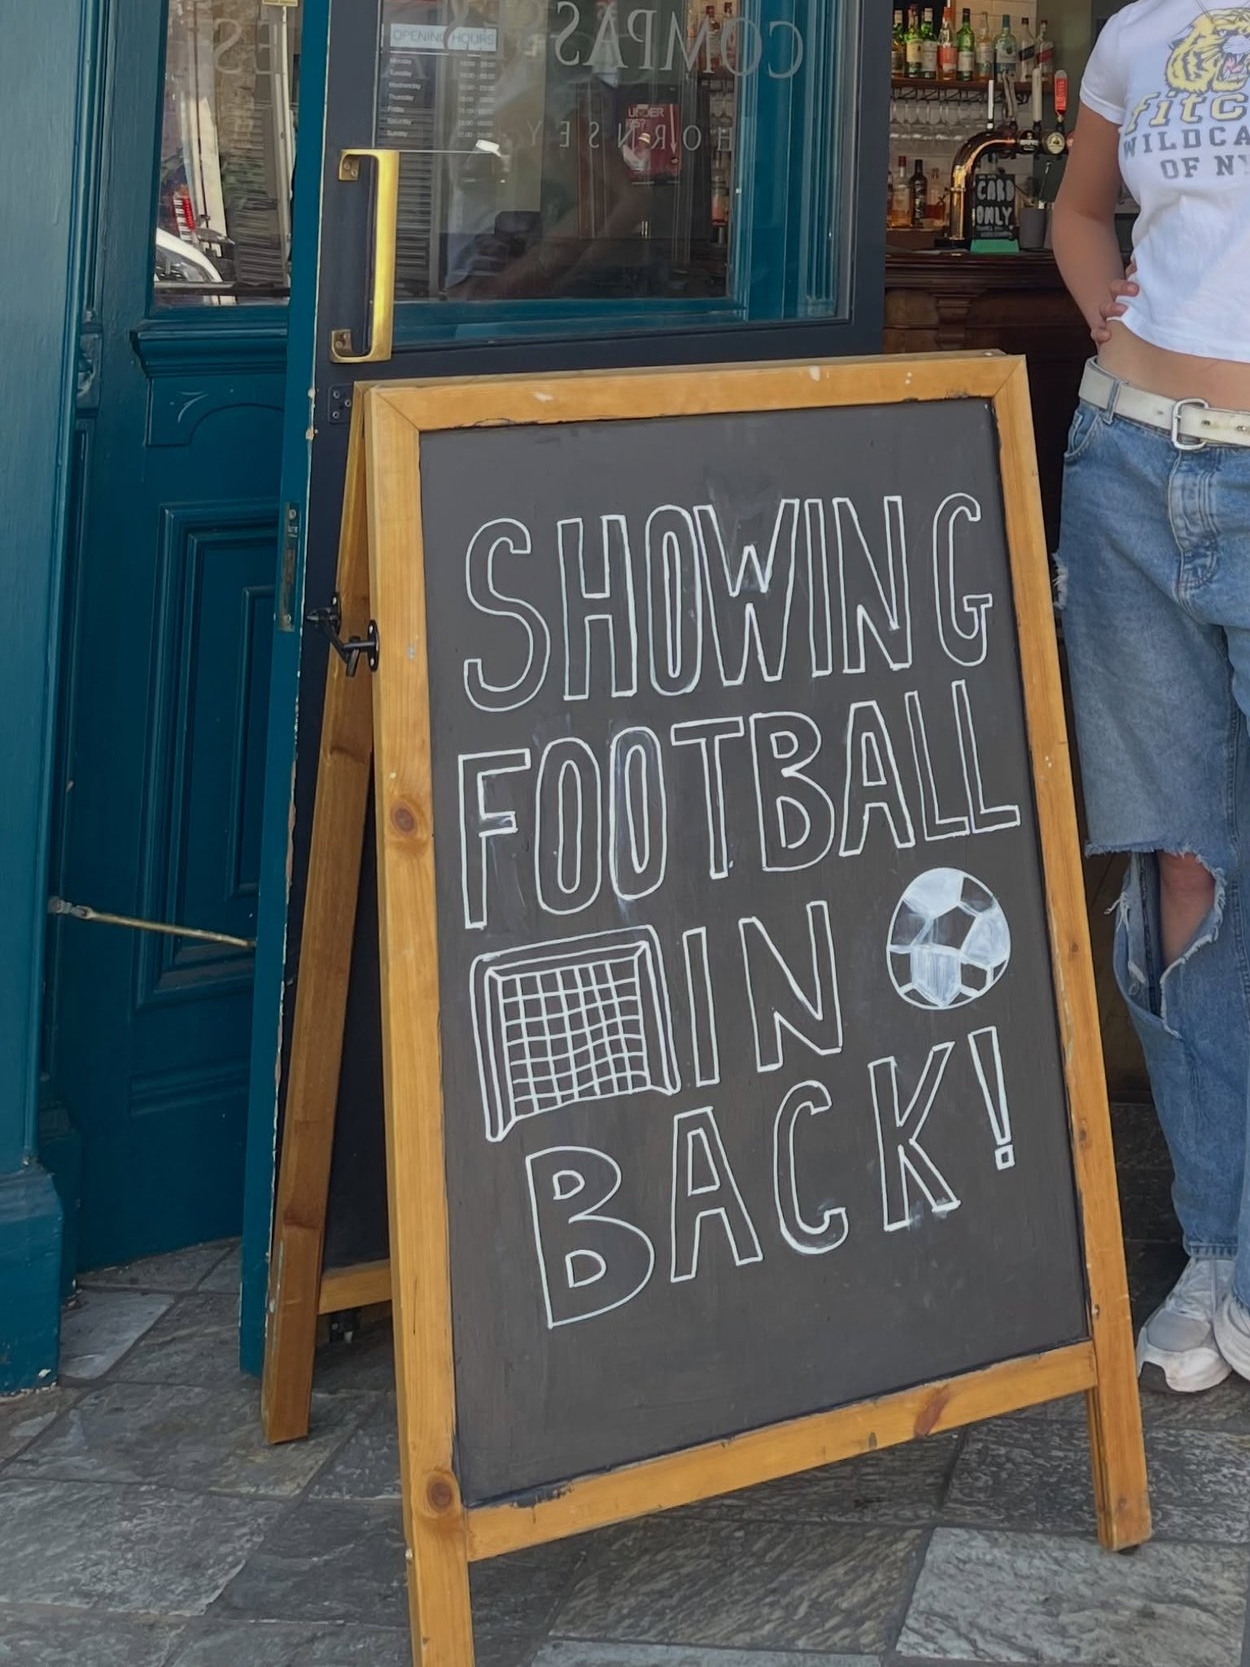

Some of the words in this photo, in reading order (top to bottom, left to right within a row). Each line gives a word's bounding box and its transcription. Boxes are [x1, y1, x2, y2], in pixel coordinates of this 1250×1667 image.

[451, 32, 496, 46] HOURS
[976, 205, 1013, 226] ONLY
[977, 178, 1015, 202] CARD
[1160, 157, 1200, 180] OF
[462, 492, 994, 712] SHOWING
[457, 680, 1021, 930] FOOTBALL
[682, 900, 843, 1087] IN
[525, 1025, 1017, 1329] BACK!
